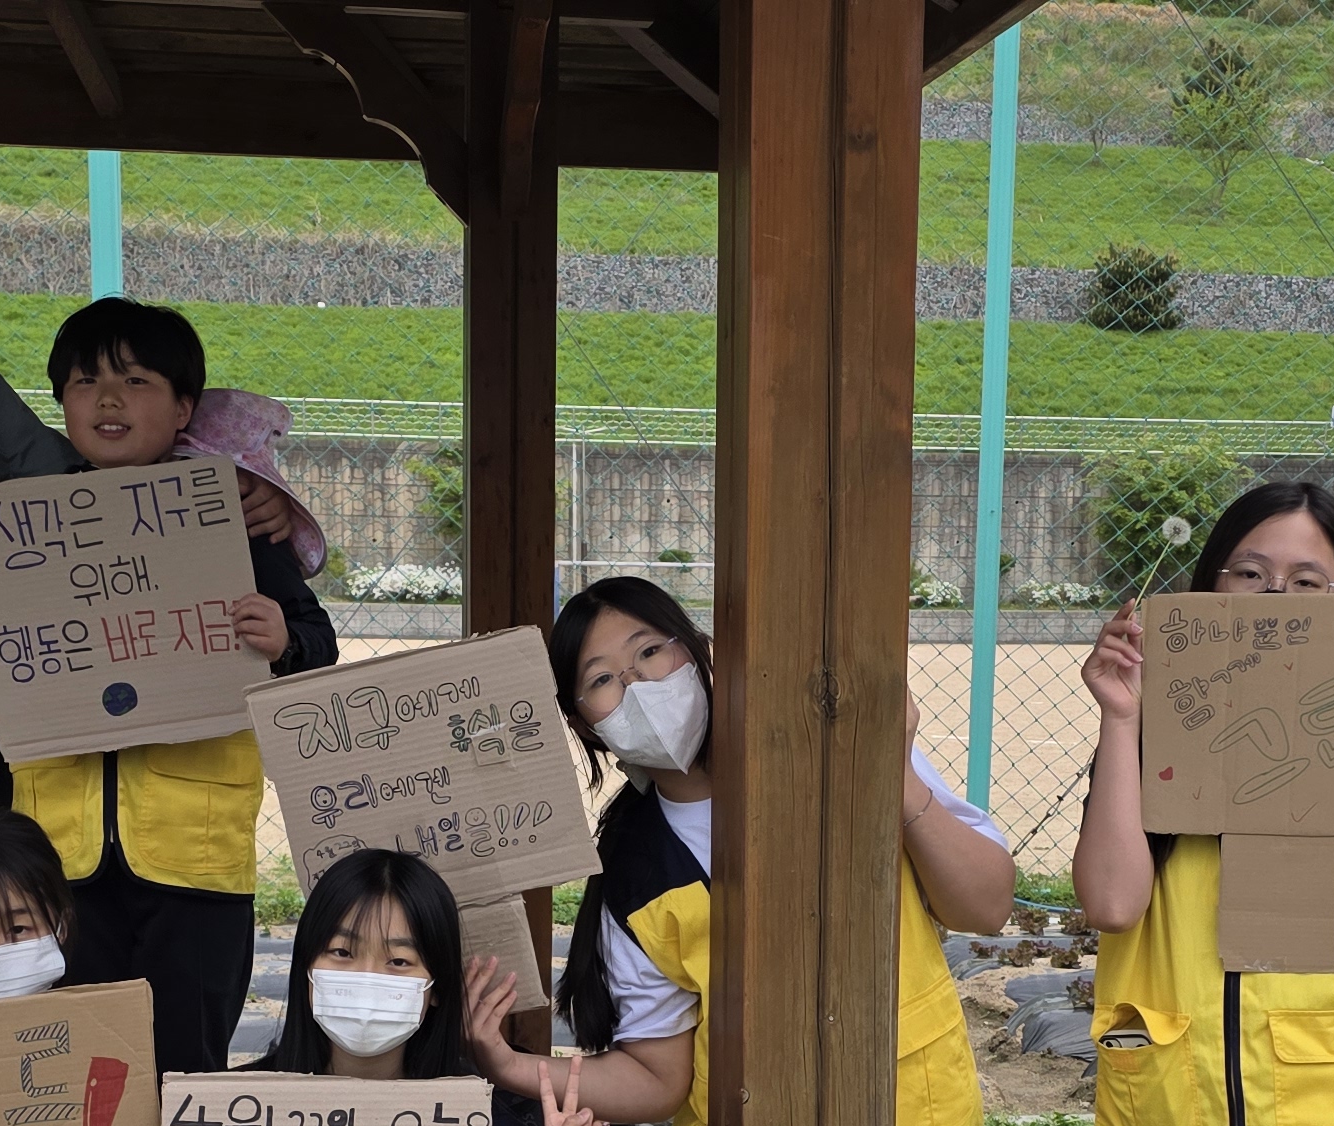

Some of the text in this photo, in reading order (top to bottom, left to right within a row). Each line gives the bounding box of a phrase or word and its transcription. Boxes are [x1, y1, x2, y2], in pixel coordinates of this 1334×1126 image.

[120, 467, 231, 537] 지구를
[101, 609, 158, 662] 바로
[1159, 608, 1312, 653] 하나뿐인
[274, 676, 544, 759] 지구에게 휴식을
[1167, 652, 1261, 731] 함께
[311, 766, 451, 829] 우리에겐
